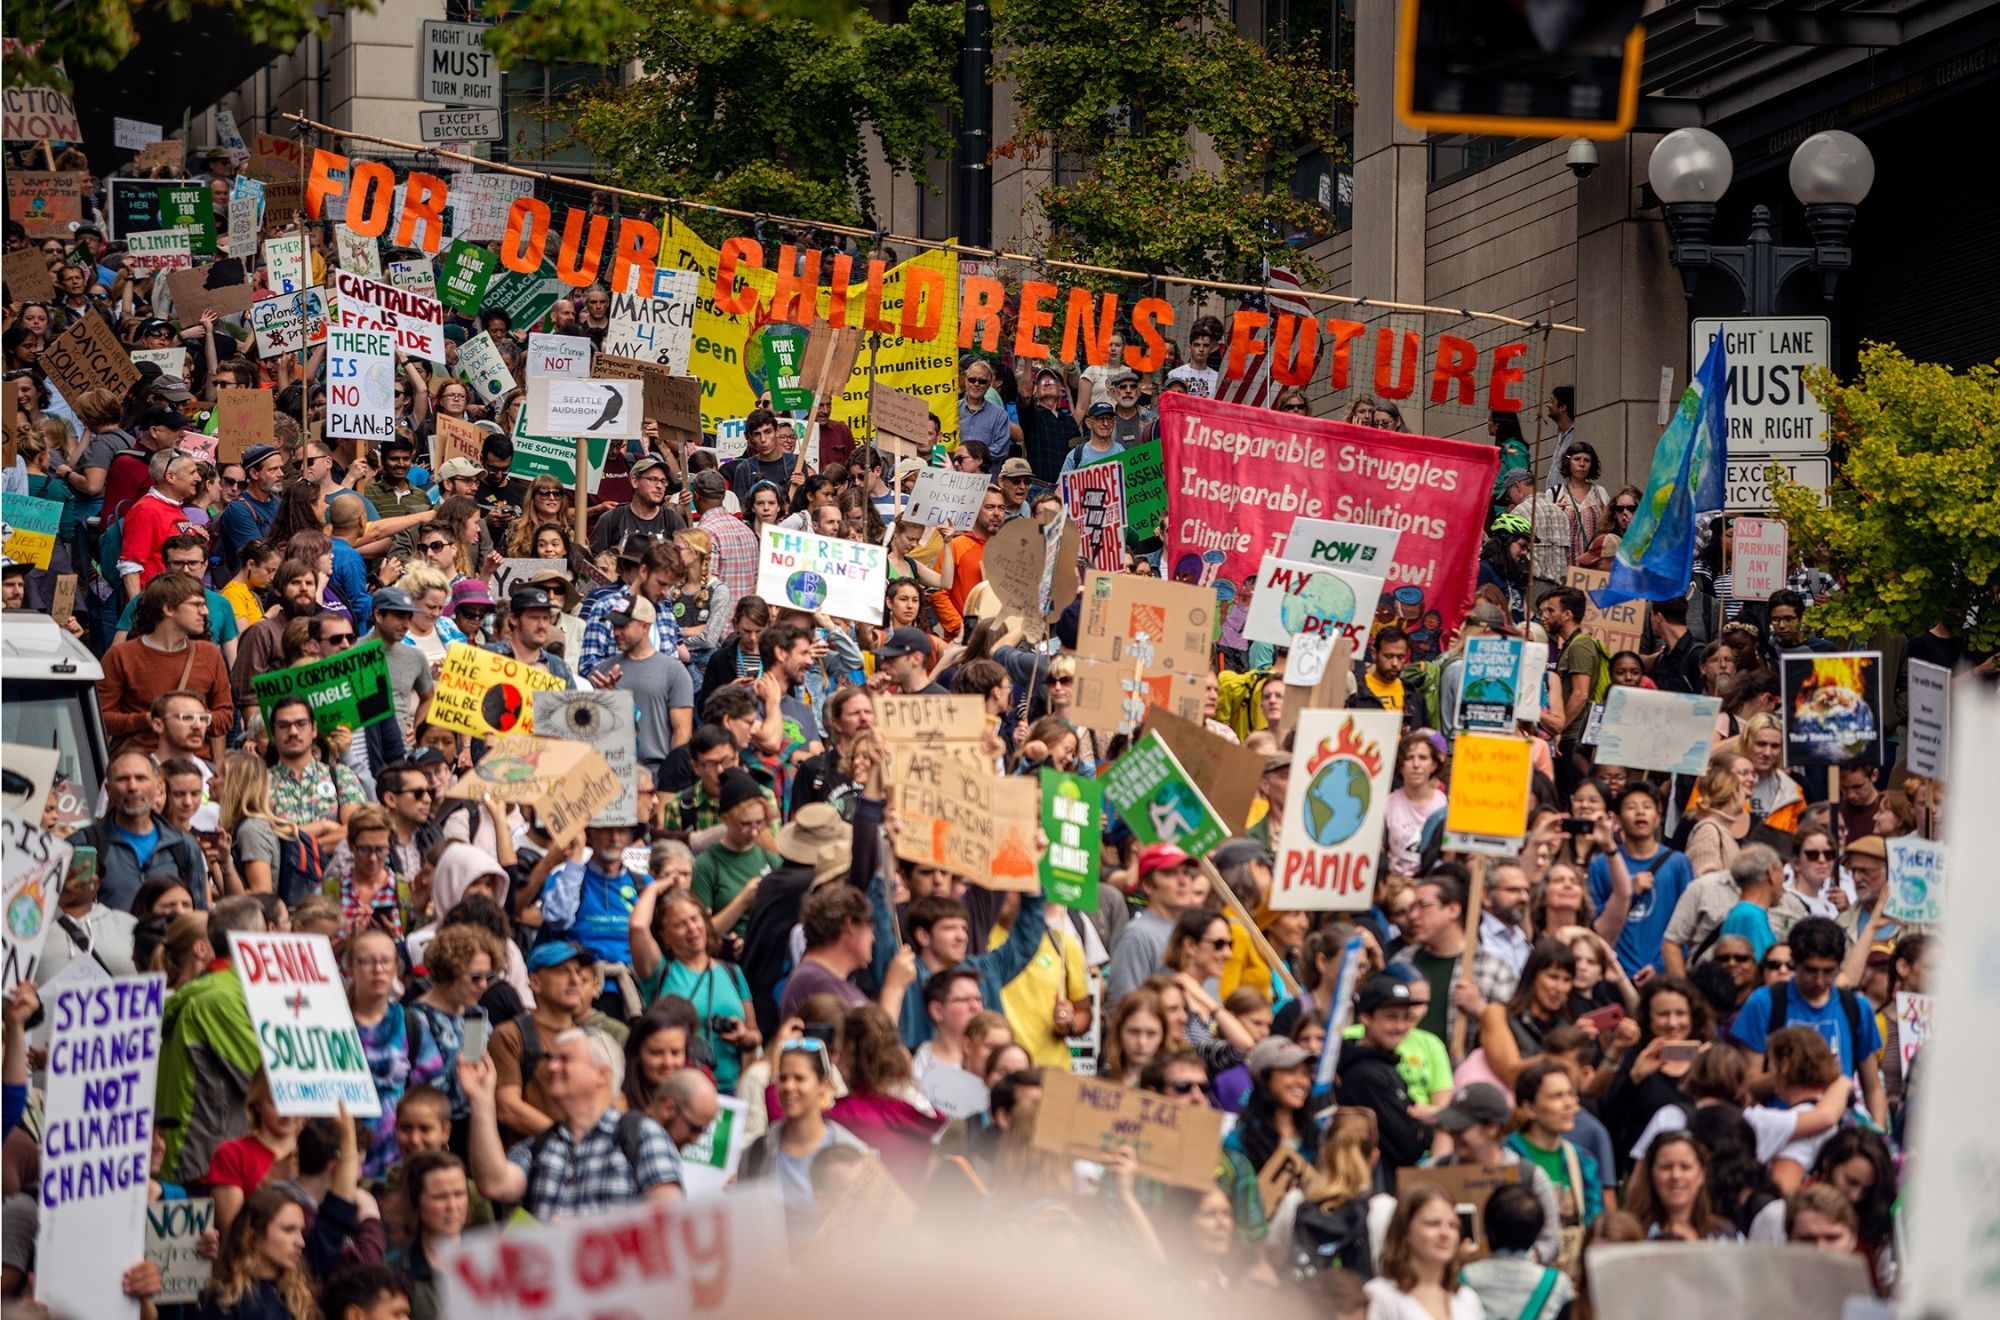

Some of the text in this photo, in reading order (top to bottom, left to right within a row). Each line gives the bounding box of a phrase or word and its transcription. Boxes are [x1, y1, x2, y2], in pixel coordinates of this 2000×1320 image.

[432, 29, 460, 45] RIGHT
[433, 49, 491, 78] MUST
[432, 81, 492, 99] TURN RIGHT
[4, 115, 78, 141] NOW
[115, 119, 136, 131] Black
[439, 112, 481, 126] EXCEPT
[434, 125, 489, 138] BICYCLES
[23, 177, 73, 187] WANT YOU
[480, 176, 533, 193] YOU DID
[120, 190, 158, 200] I'm with
[129, 200, 149, 210] HER
[171, 191, 200, 204] PEOPLE
[179, 204, 195, 216] FOR
[128, 233, 189, 251] CLIMATE
[131, 253, 192, 269] EMERGENCY
[273, 257, 282, 267] IS
[391, 263, 412, 273] The
[456, 253, 485, 273] NATURE
[306, 148, 1527, 413] FOR OUR CHILDRENS FUTURE
[392, 271, 433, 285] Climate
[447, 275, 478, 296] CLIMATE
[458, 269, 474, 281] FOR
[283, 279, 294, 294] B
[484, 277, 514, 308] DON'T
[513, 279, 546, 312] SOUTHEND
[338, 273, 442, 326] CAPITALISM
[380, 310, 398, 328] IS
[611, 293, 695, 328] MARCH
[331, 332, 391, 357] THERE
[637, 324, 655, 351] 4
[771, 339, 796, 353] PEOPLE
[1770, 331, 1814, 354] LANE
[70, 322, 128, 396] DAYCARE
[457, 342, 490, 366] RESPECT
[560, 342, 586, 361] Change
[612, 342, 643, 358] MY
[780, 353, 793, 366] FOR
[331, 357, 358, 378] IS
[469, 352, 492, 375] YOUR
[545, 356, 573, 371] NOT
[593, 366, 626, 379] person
[596, 354, 634, 371] Empower
[852, 356, 953, 376] ommunities
[471, 362, 505, 385] MOTHER
[332, 384, 360, 407] NO
[562, 395, 603, 405] SEATTLE
[551, 406, 598, 415] AUDUBON
[650, 399, 697, 424] HOME
[1764, 417, 1814, 440] RIGHT
[516, 440, 534, 451] THE
[1182, 414, 1460, 494] Inseparable Struggles
[1129, 450, 1152, 467] are
[921, 471, 990, 493] OUR CHILDREN
[1069, 463, 1119, 520] CHOOSE
[929, 490, 967, 505] DESERVE
[1180, 466, 1447, 540] Inseparable Solutions
[927, 506, 975, 527] FUTURE
[1179, 517, 1252, 554] Climate
[1738, 520, 1760, 537] NO
[11, 532, 48, 549] NEED
[769, 531, 880, 569] THERE IS
[1737, 542, 1782, 557] PARKING
[771, 552, 871, 582] NO PLANET
[1386, 559, 1438, 589] ow!
[1747, 560, 1770, 574] ANY
[804, 572, 820, 594] B
[1266, 566, 1314, 597] MY
[1746, 576, 1771, 591] TIME
[450, 659, 481, 680] THE
[1467, 651, 1518, 667] URGENCY
[254, 645, 386, 699] HOLD CORPORATIONS
[462, 649, 564, 692] IN 50 YEARS
[1468, 664, 1514, 679] OF NOW
[440, 671, 487, 698] PLANET
[436, 690, 478, 712] WILL BE
[1465, 709, 1506, 723] STRIKE
[1788, 732, 1808, 743] Your
[907, 751, 991, 812] ARE YOU
[568, 770, 613, 821] together
[902, 786, 993, 838] FRACKING
[1049, 842, 1089, 875] CLIMATE
[1893, 846, 1944, 872] THERE
[1926, 899, 1942, 920] B
[237, 939, 330, 984] DENIAL
[51, 1026, 156, 1076] CHANGE
[259, 1019, 366, 1073] SOLUTION
[83, 1071, 140, 1113] NOT
[45, 1108, 150, 1158] CLIMATE
[42, 1153, 147, 1209] CHANGE
[146, 1203, 213, 1239] NOW
